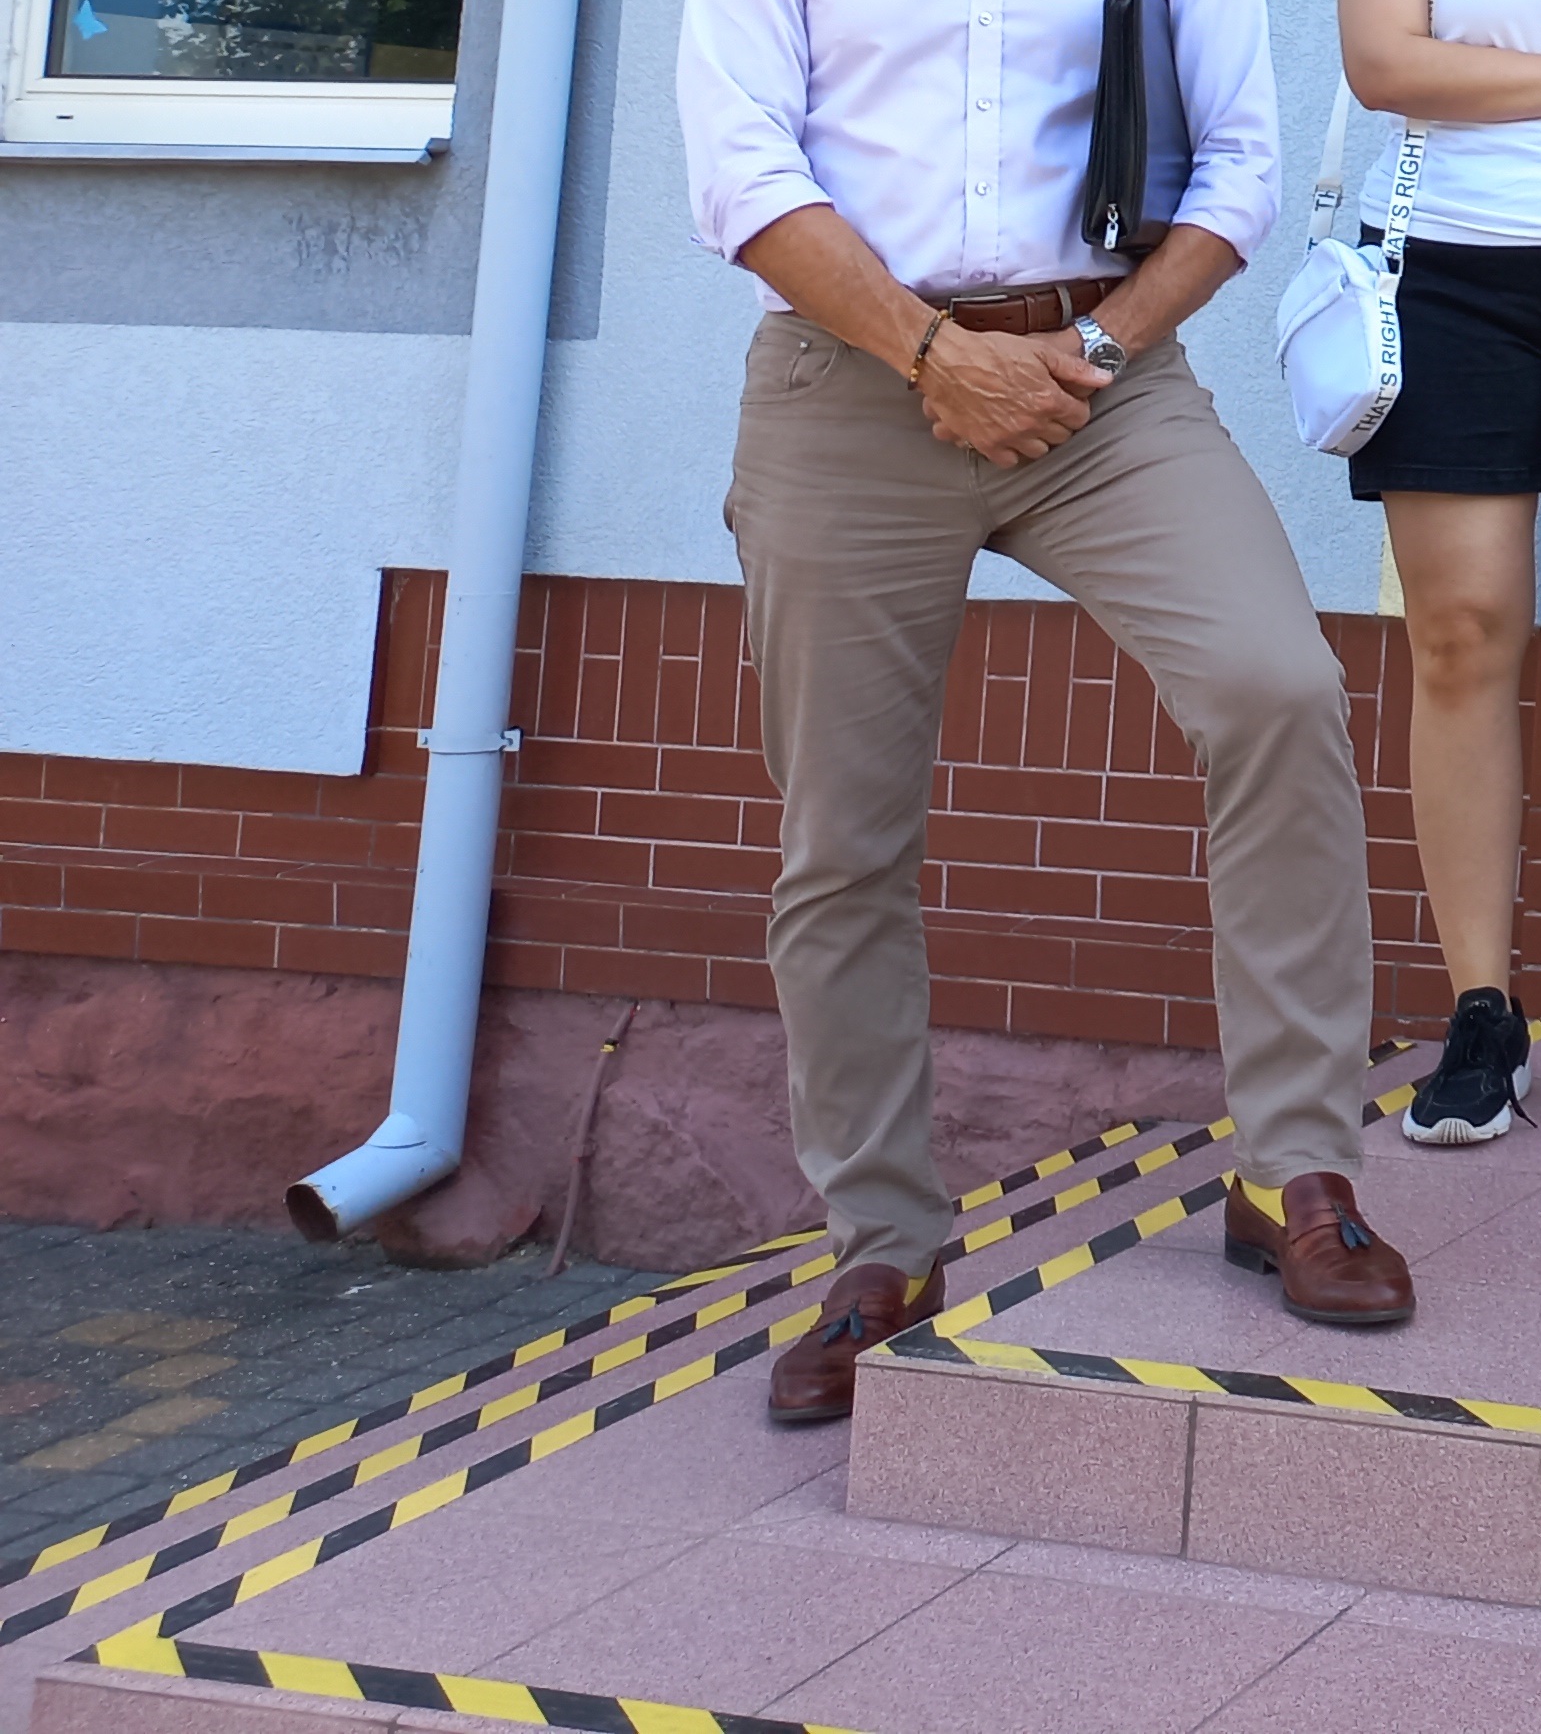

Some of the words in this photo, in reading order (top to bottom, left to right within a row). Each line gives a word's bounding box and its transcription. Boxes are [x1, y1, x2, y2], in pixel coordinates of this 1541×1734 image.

[1395, 128, 1425, 198] RIGHT
[1352, 372, 1398, 433] THAT'S
[1379, 296, 1397, 366] RIGHT
